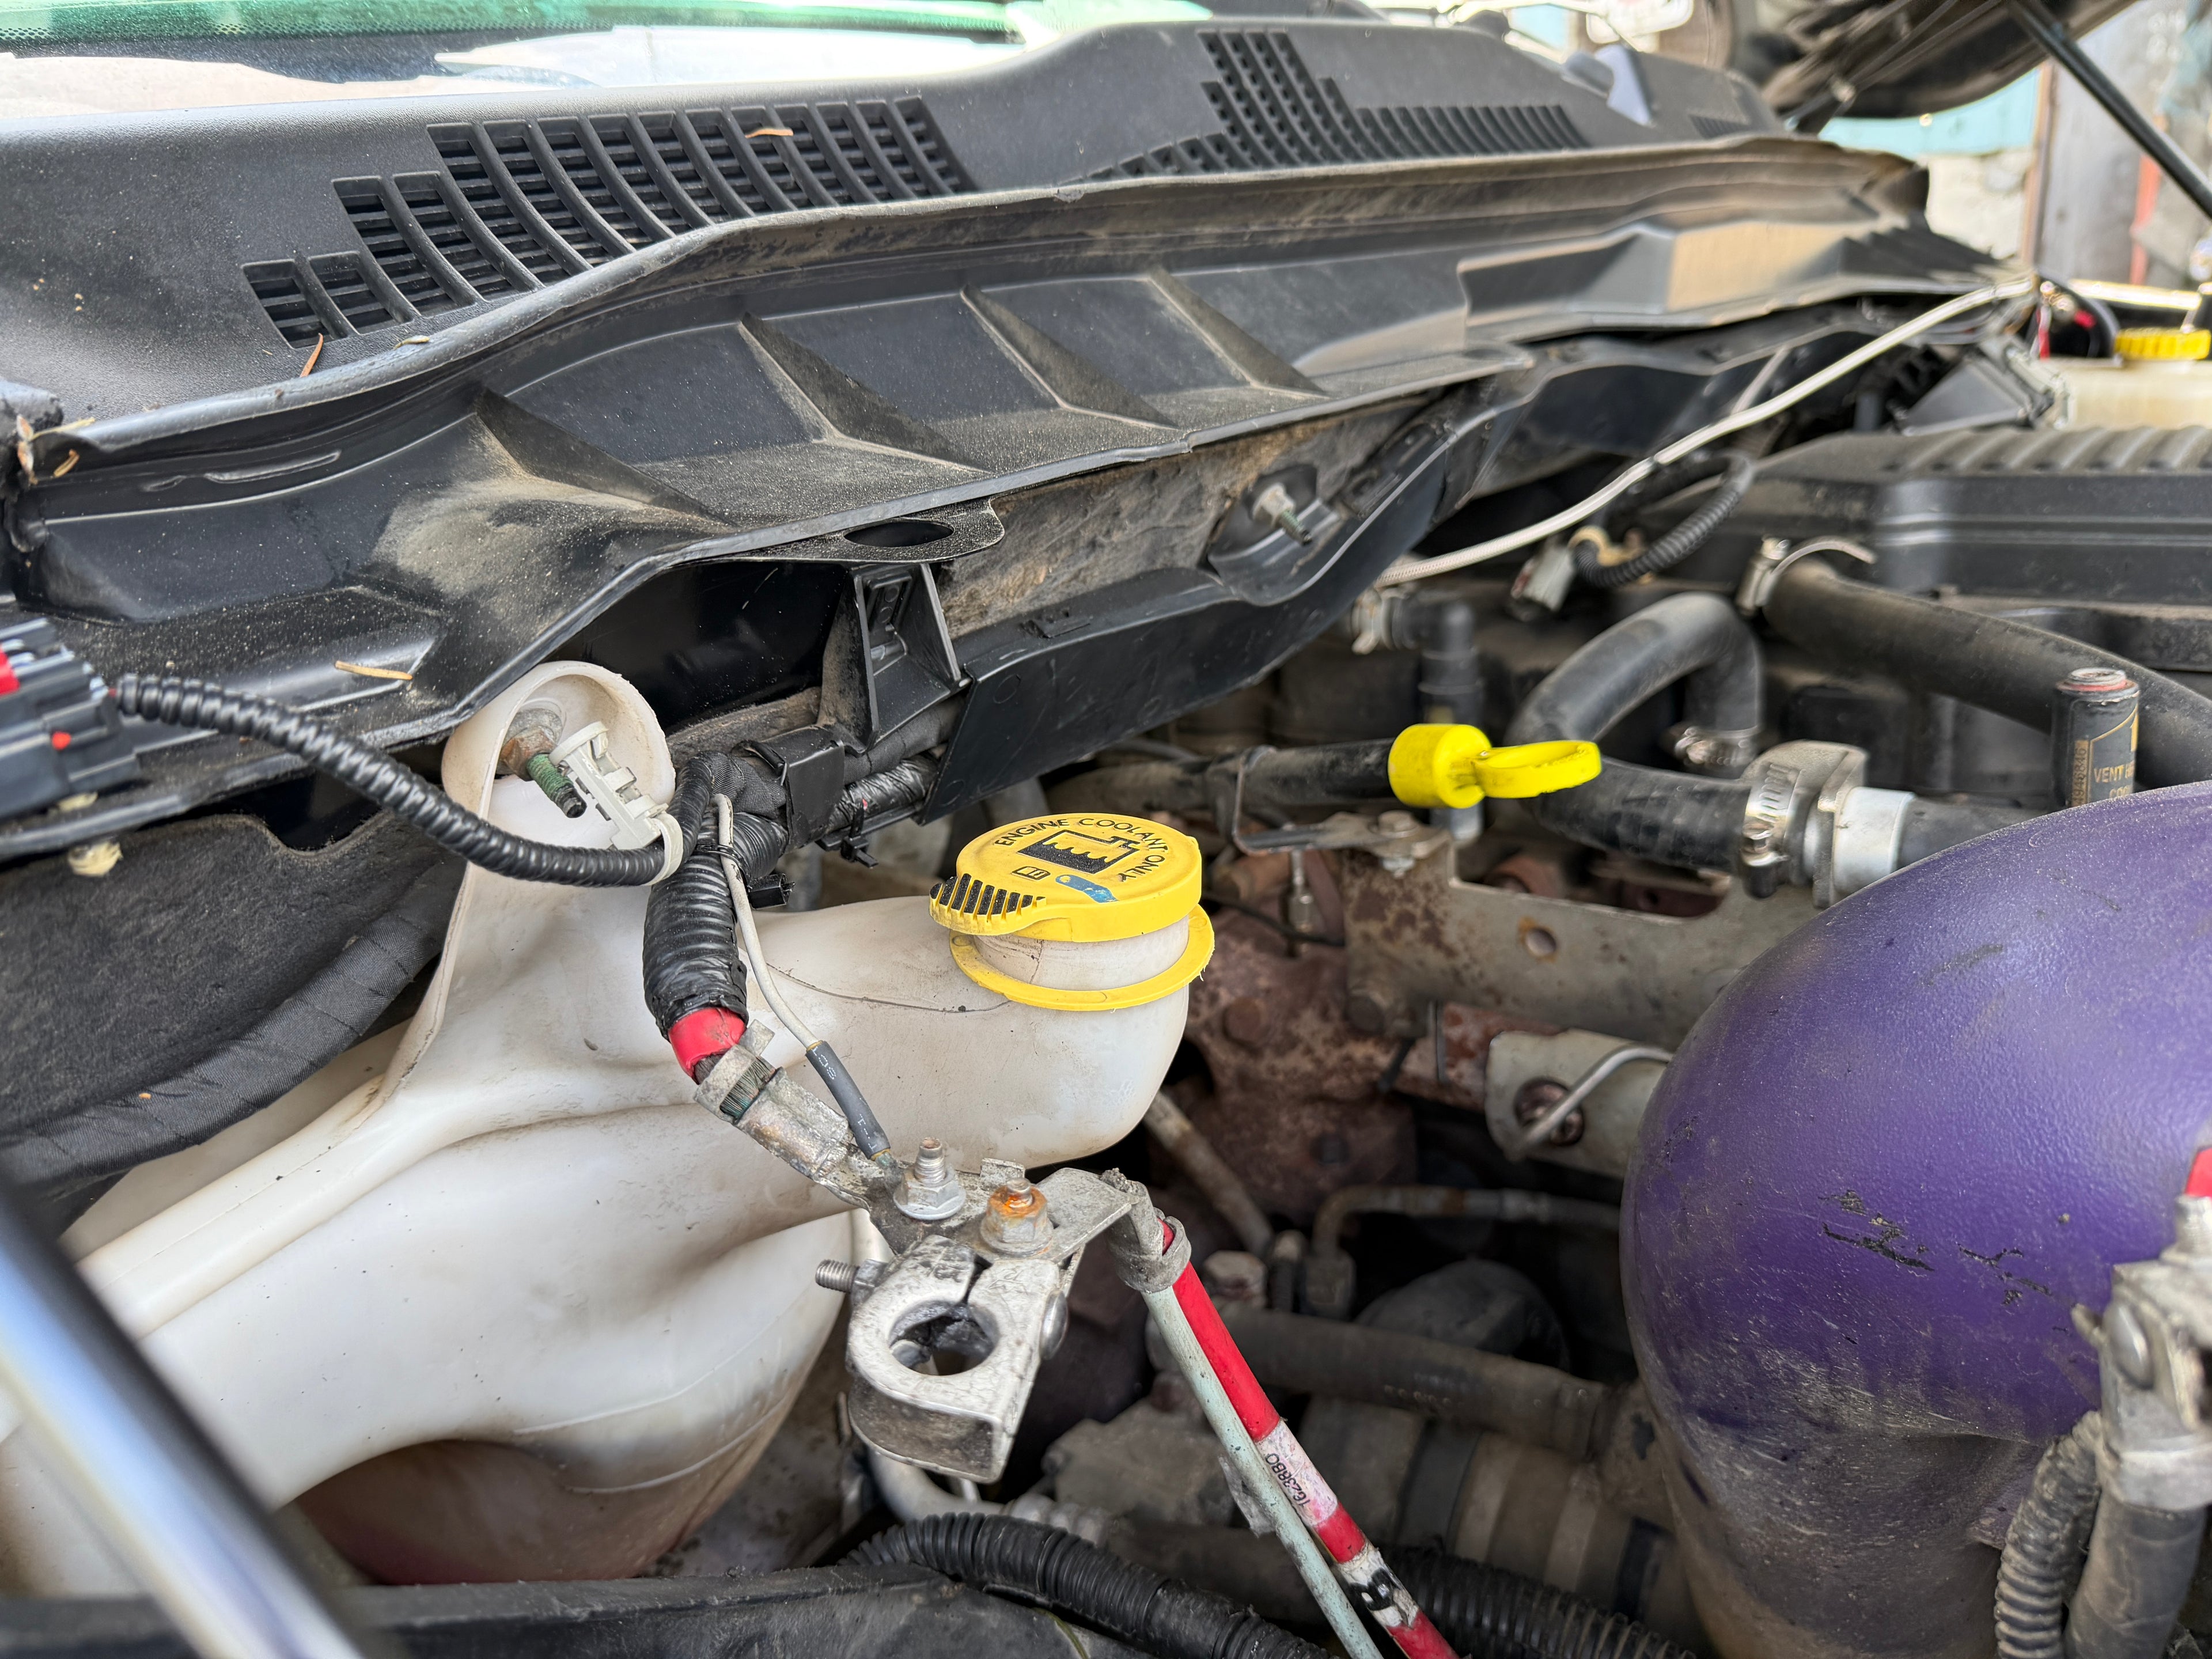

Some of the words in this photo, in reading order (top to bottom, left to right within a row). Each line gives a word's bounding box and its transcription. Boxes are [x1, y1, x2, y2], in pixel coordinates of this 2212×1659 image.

[2093, 764, 2125, 783] VENT
[995, 818, 1070, 847] ENGINE
[1078, 817, 1169, 854] COOLANT
[1118, 854, 1165, 882] ONLY
